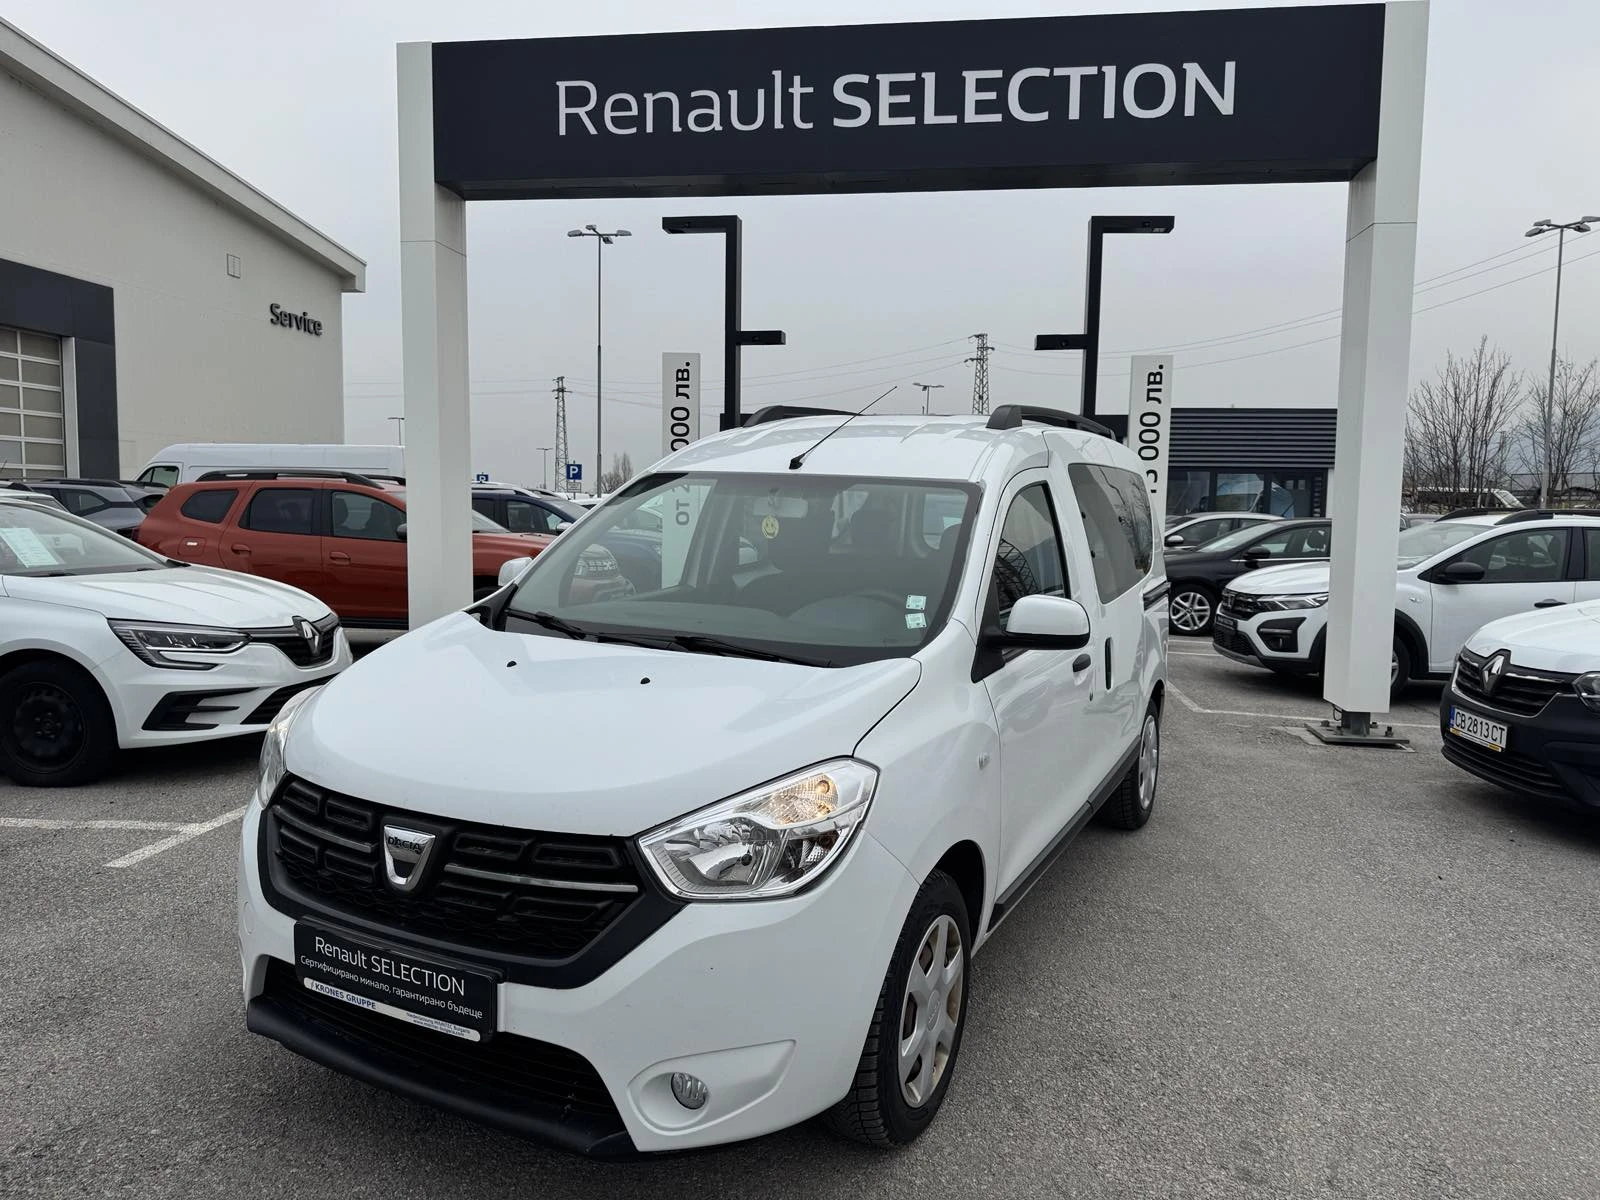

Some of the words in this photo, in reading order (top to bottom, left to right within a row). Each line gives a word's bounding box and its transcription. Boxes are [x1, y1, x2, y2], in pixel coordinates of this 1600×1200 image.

[555, 69, 815, 136] Renault
[832, 60, 1237, 128] SELECTION
[269, 302, 323, 337] Service
[675, 361, 691, 400] лв.
[1145, 363, 1165, 405] лв.
[1137, 411, 1162, 461] 000
[300, 955, 359, 982] Сертифицирано
[360, 976, 391, 995] минало,
[392, 986, 446, 1009] гарантирано
[447, 1000, 483, 1019] бъдеще
[315, 936, 368, 969] Renault
[371, 955, 465, 997] SELECTION
[314, 982, 345, 999] KRONES
[345, 994, 377, 1010] GRUPPE
